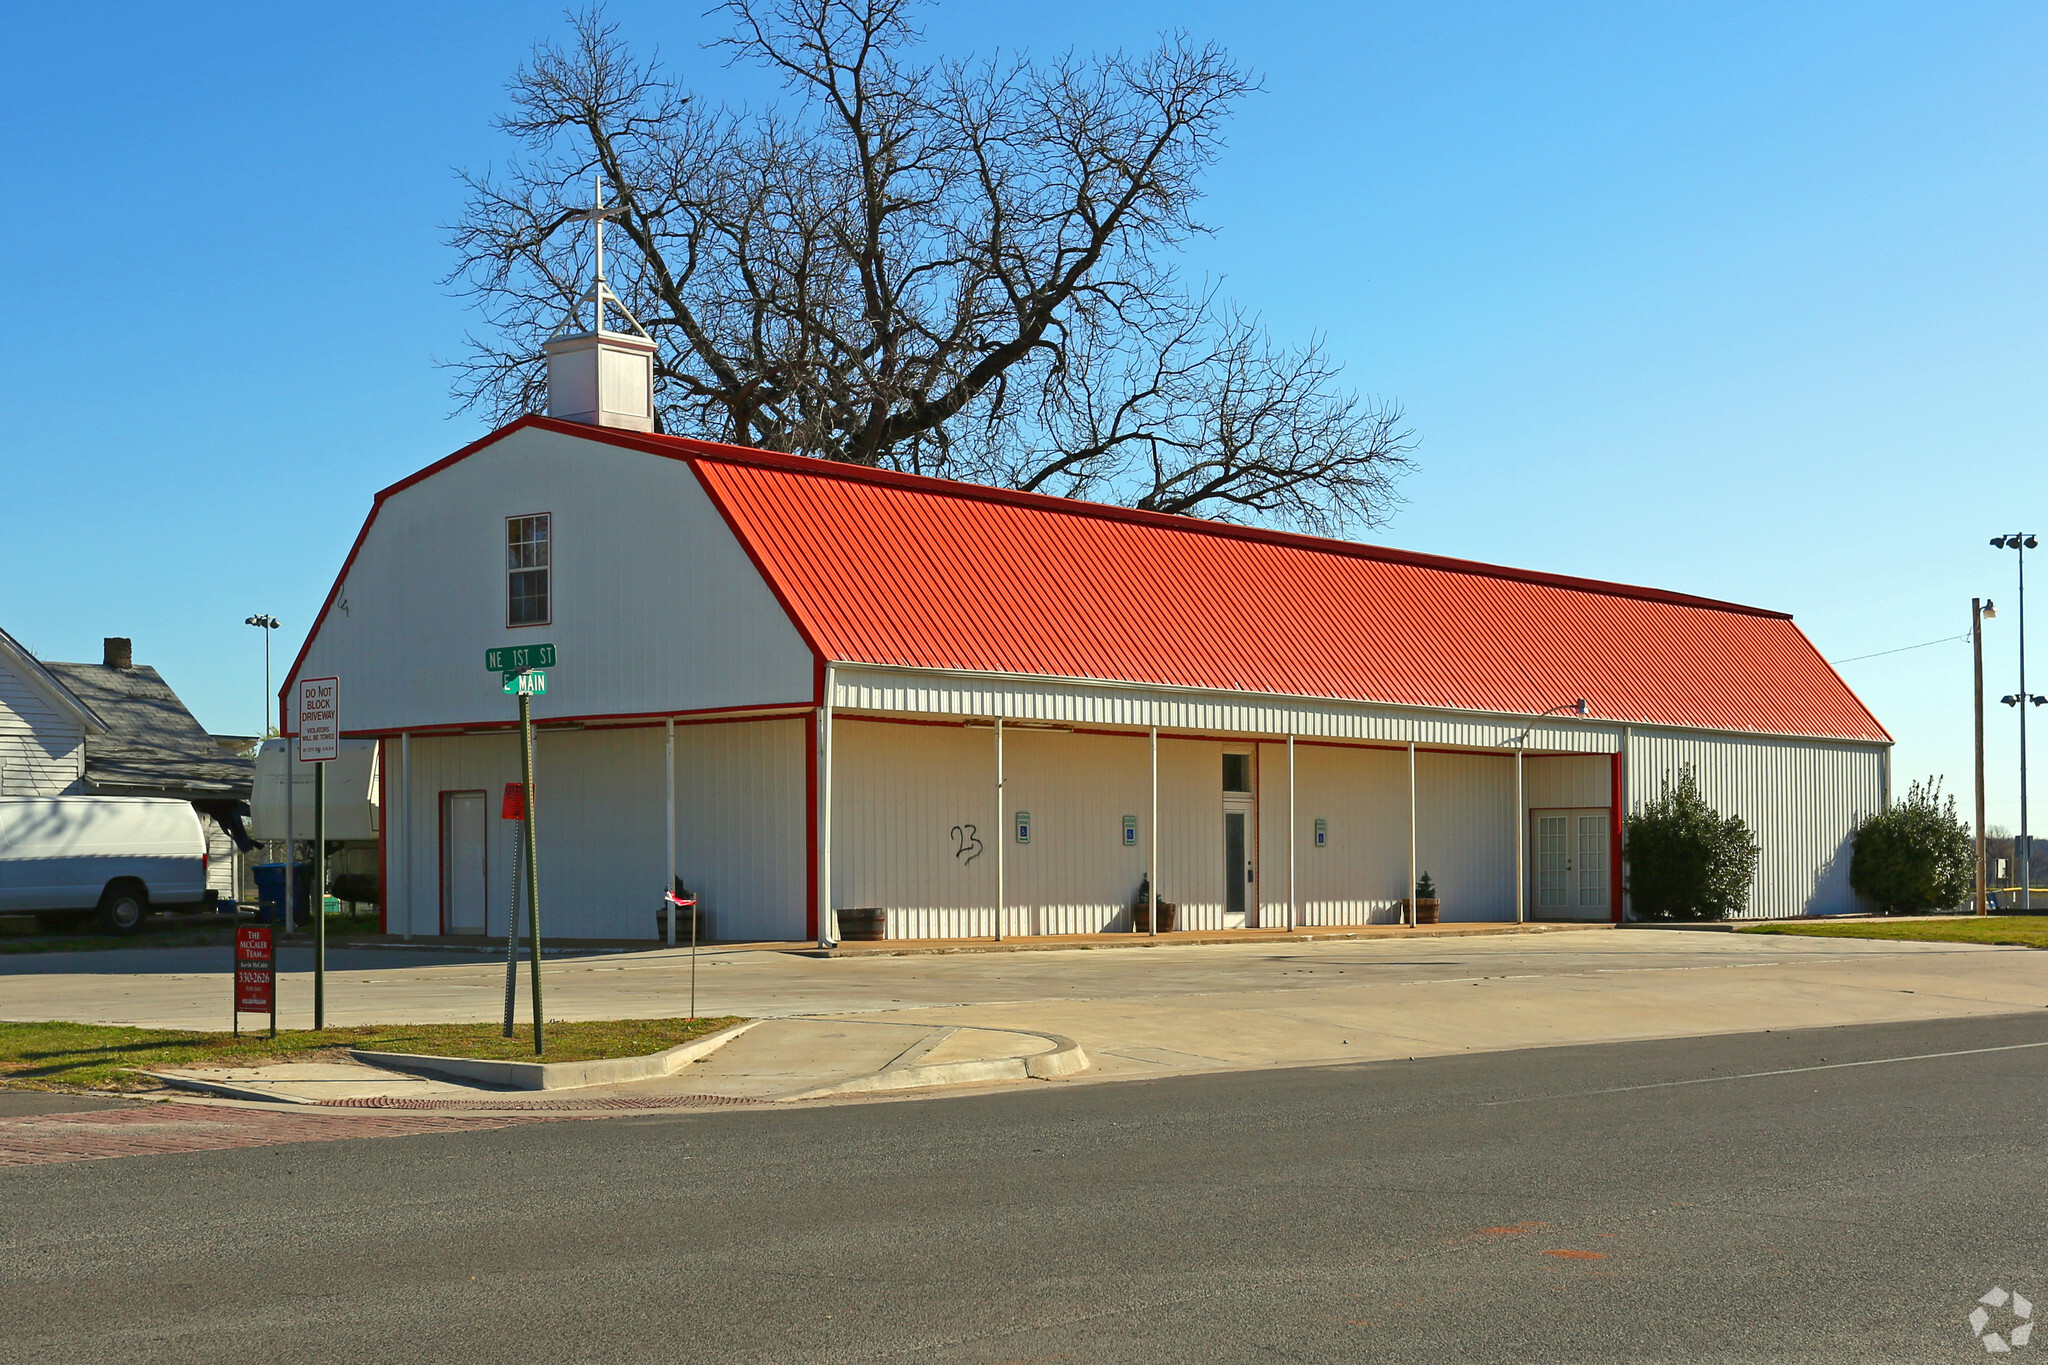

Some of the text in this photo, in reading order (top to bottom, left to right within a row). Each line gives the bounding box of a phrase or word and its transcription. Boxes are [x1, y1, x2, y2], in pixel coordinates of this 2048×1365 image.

[489, 647, 552, 668] NE 1ST ST
[504, 674, 545, 692] E MAIN
[305, 687, 332, 699] DO NOT
[307, 699, 331, 710] BLOCK
[302, 710, 335, 722] DRIVEWAY
[307, 726, 330, 734] VIOLATORS
[950, 824, 983, 866] 23
[247, 930, 260, 940] THE
[246, 949, 262, 958] TEAM
[239, 972, 270, 983] 330-2626
